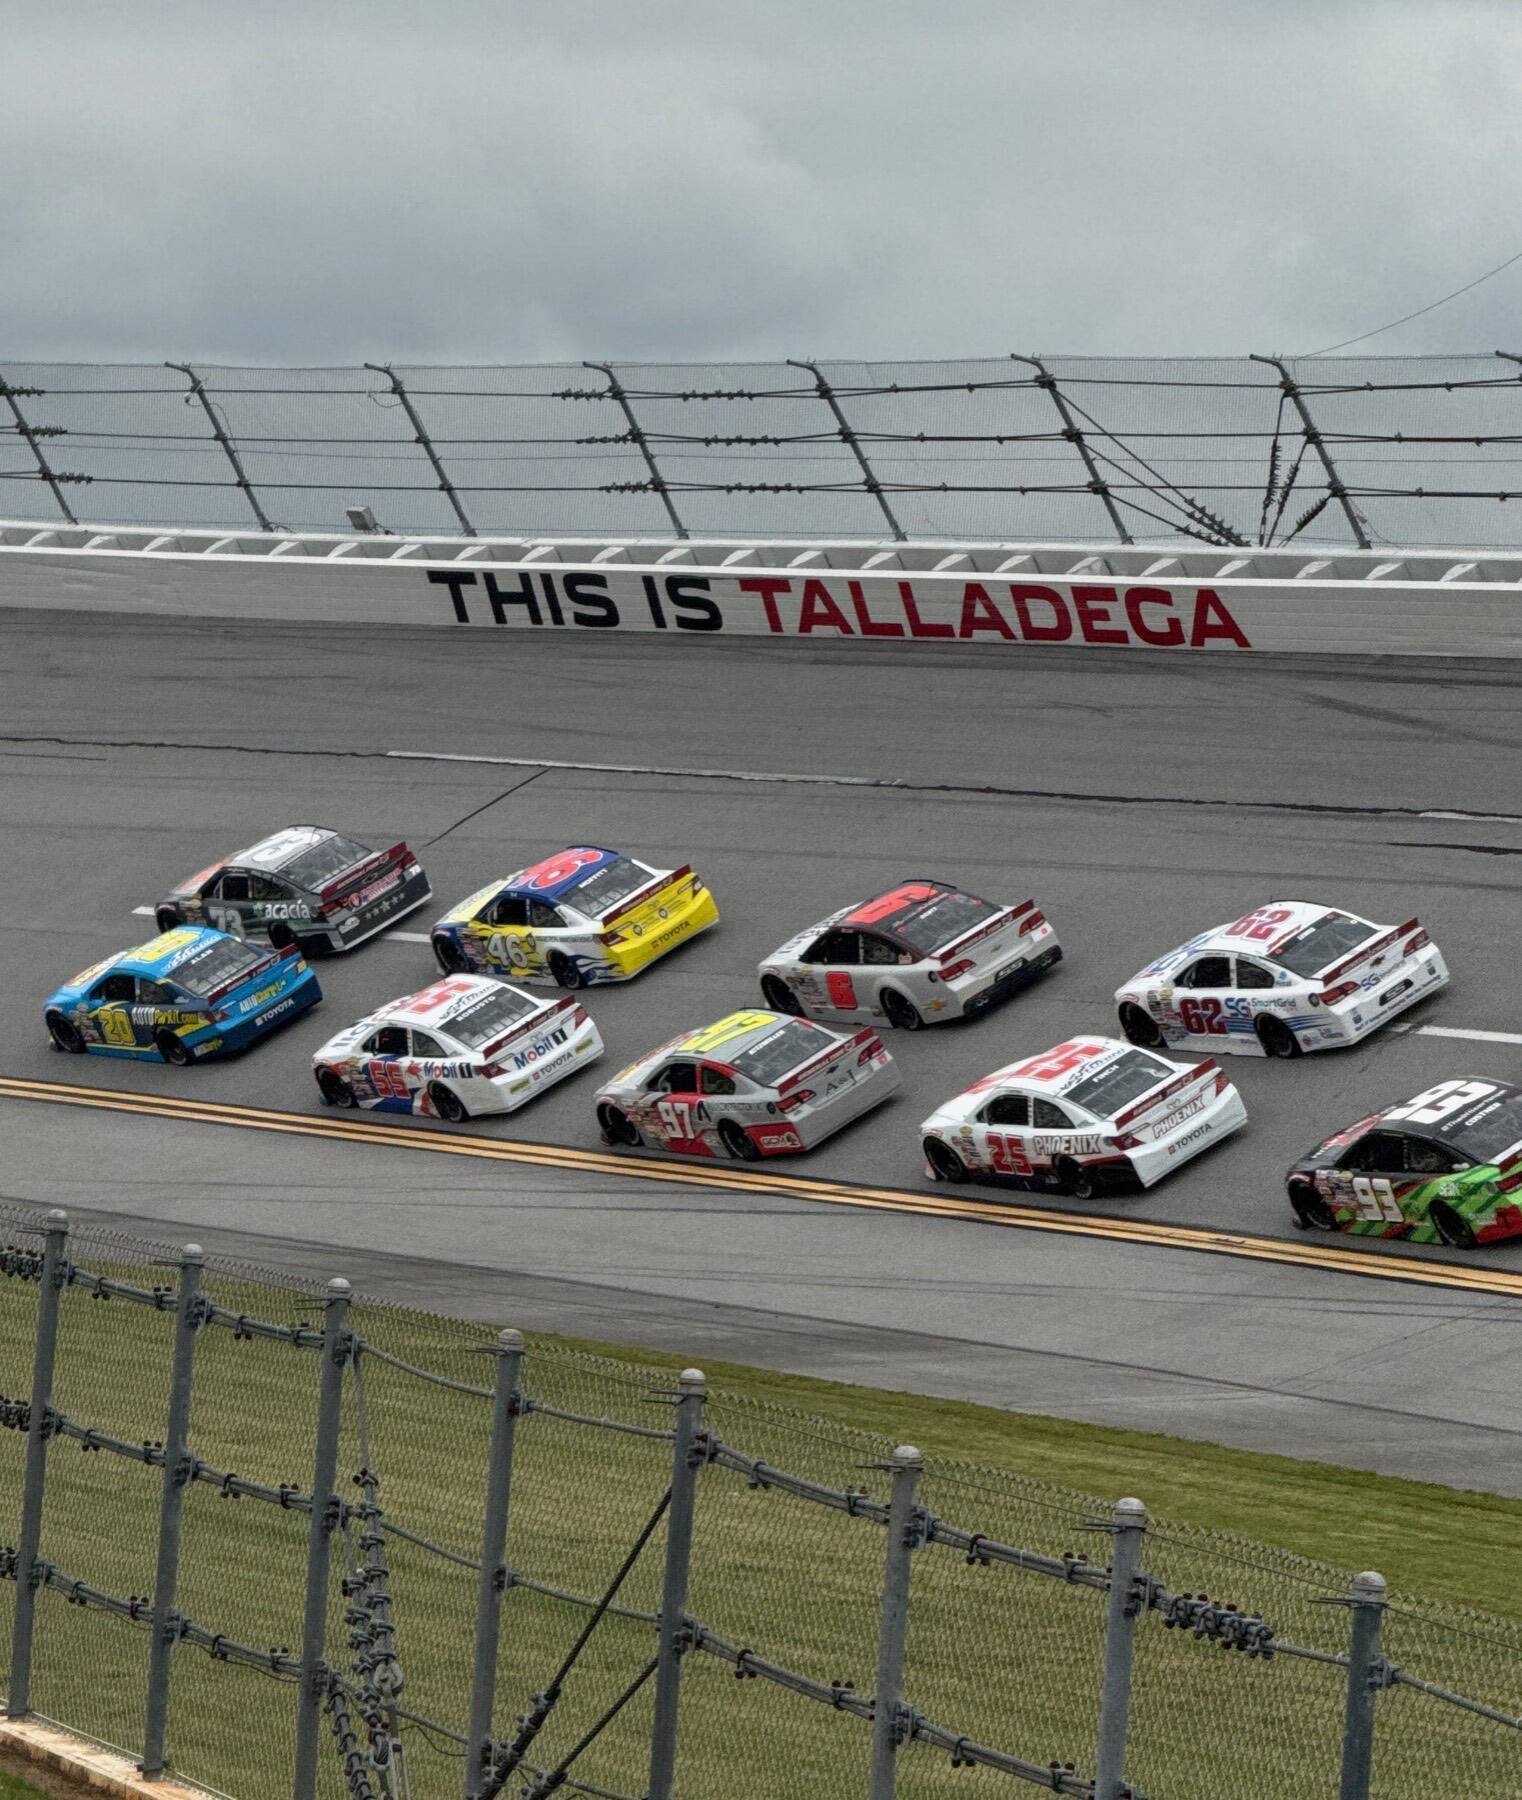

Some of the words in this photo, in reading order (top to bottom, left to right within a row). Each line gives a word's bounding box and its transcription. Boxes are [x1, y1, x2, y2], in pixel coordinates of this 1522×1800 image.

[427, 570, 620, 628] THIS
[643, 575, 724, 632] IS
[739, 577, 1252, 650] TALLADEGA
[208, 906, 246, 942] 73
[265, 900, 310, 920] acacia
[1221, 908, 1294, 942] 62
[487, 932, 528, 969] 46
[659, 920, 691, 945] TOYOTA
[262, 998, 295, 1022] TOYOTA
[1179, 997, 1229, 1036] 62
[1225, 997, 1250, 1018] SG
[424, 1061, 458, 1079] Mobil
[513, 1035, 554, 1071] Mobil
[540, 1051, 574, 1076] TOYOTA
[368, 1060, 412, 1099] 55
[1152, 1096, 1206, 1140] PHOENIX
[1382, 1079, 1498, 1125] 93
[1464, 1102, 1503, 1126] COSTNER
[656, 1102, 695, 1140] 97
[1176, 1122, 1213, 1151] TOYOTA
[985, 1131, 1034, 1176] 25
[1032, 1134, 1102, 1156] PHOENIX
[1352, 1177, 1405, 1223] 93
